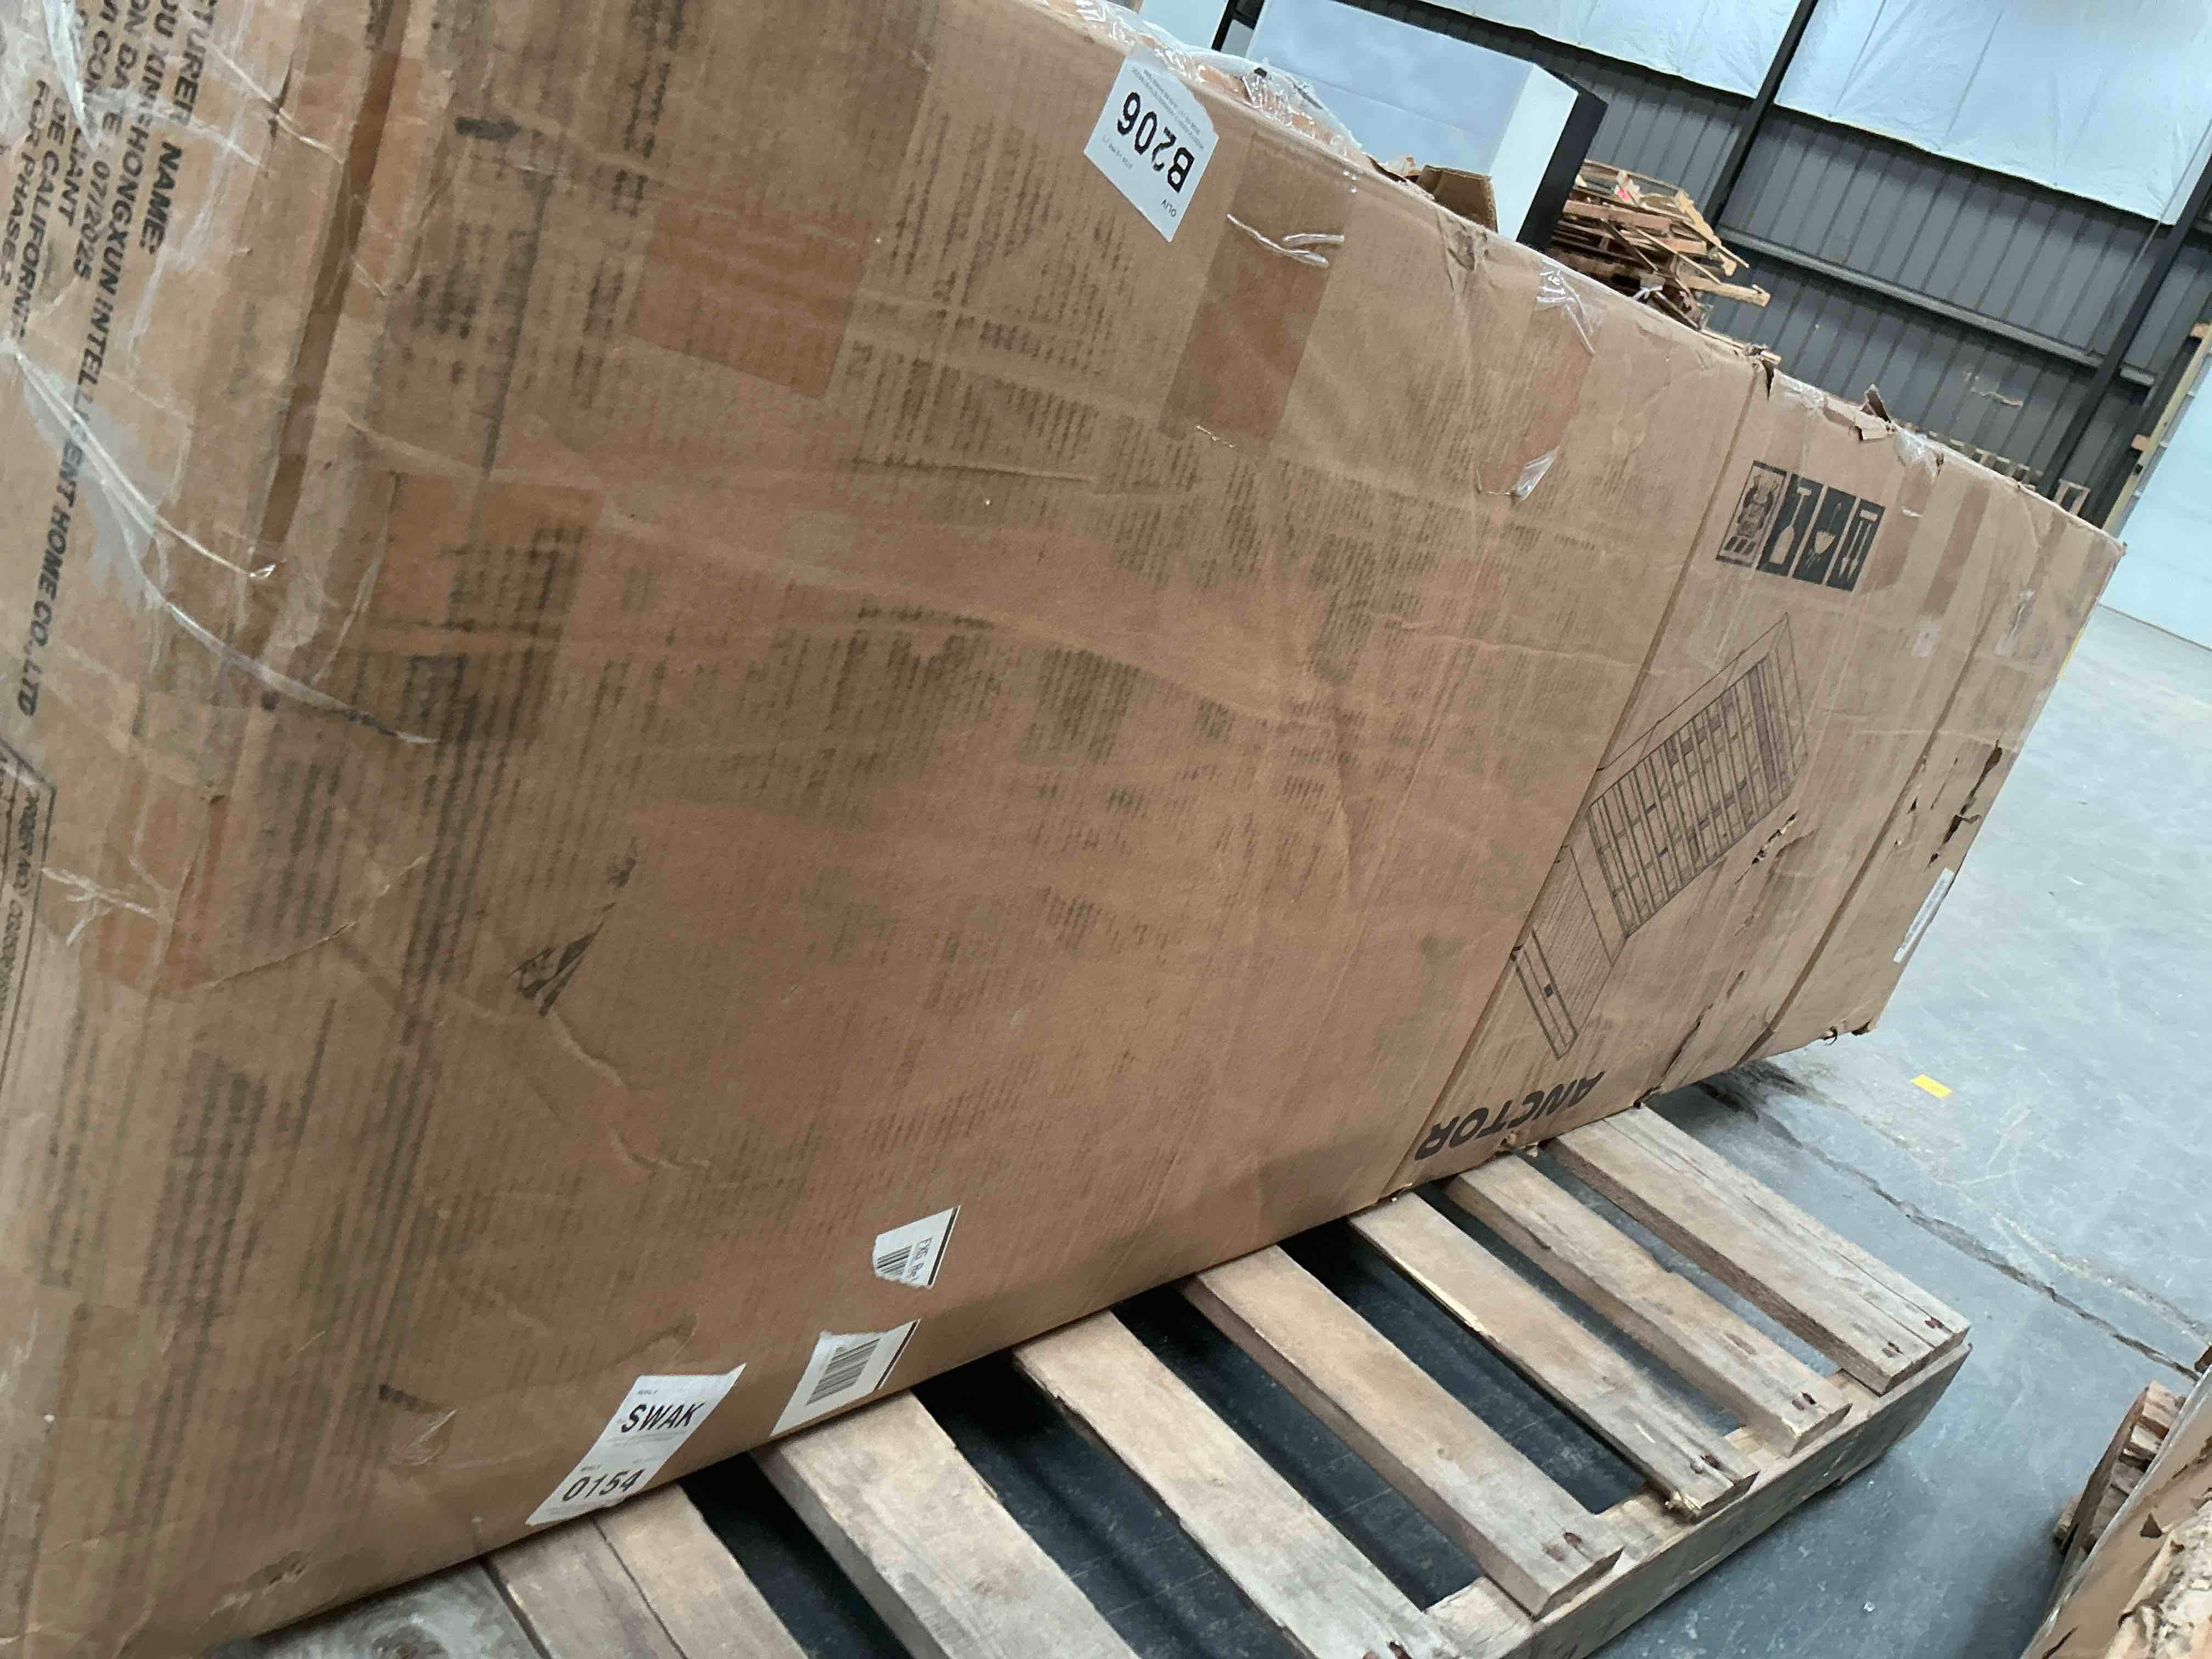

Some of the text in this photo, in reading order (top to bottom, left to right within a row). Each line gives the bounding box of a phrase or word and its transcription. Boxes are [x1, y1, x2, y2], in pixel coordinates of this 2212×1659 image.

[1117, 92, 1195, 193] B206
[2, 151, 36, 262] PHASE
[73, 160, 110, 280] 07/2025
[139, 140, 183, 255] NAME:
[1160, 199, 1177, 217] OLIV
[39, 505, 71, 601] HOME
[621, 1402, 706, 1433] SWAK
[562, 1468, 645, 1502] 0154
